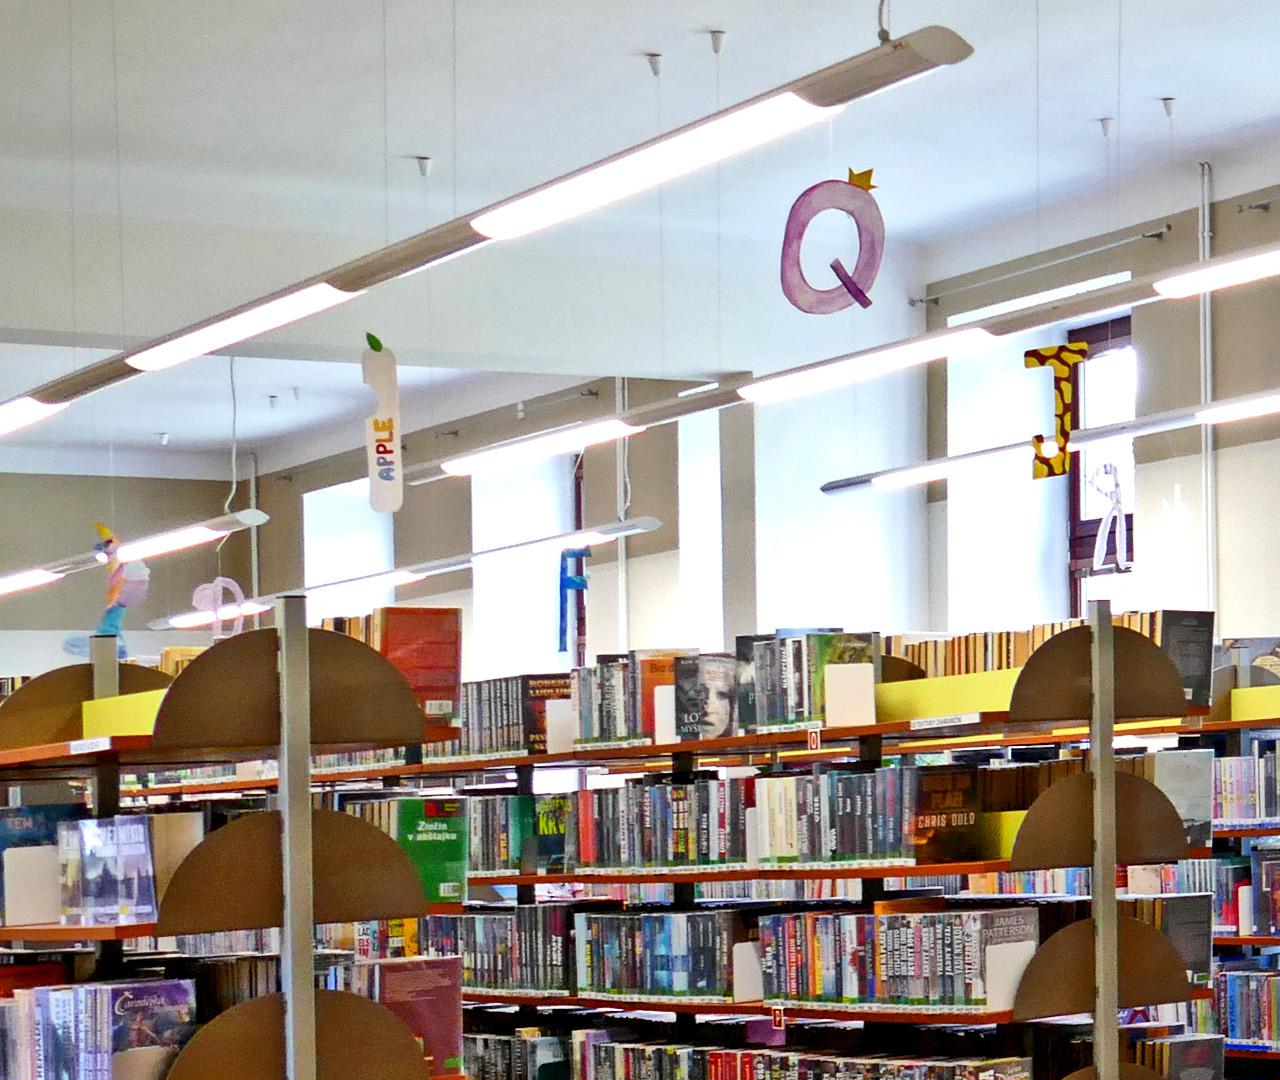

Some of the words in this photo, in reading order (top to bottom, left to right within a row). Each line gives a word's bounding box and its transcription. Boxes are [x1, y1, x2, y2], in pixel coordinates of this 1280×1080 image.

[780, 179, 886, 315] Q
[373, 417, 395, 481] APPLE
[918, 815, 947, 829] CHRIS
[994, 915, 1025, 927] JAMES
[983, 924, 1034, 937] PATTERSON
